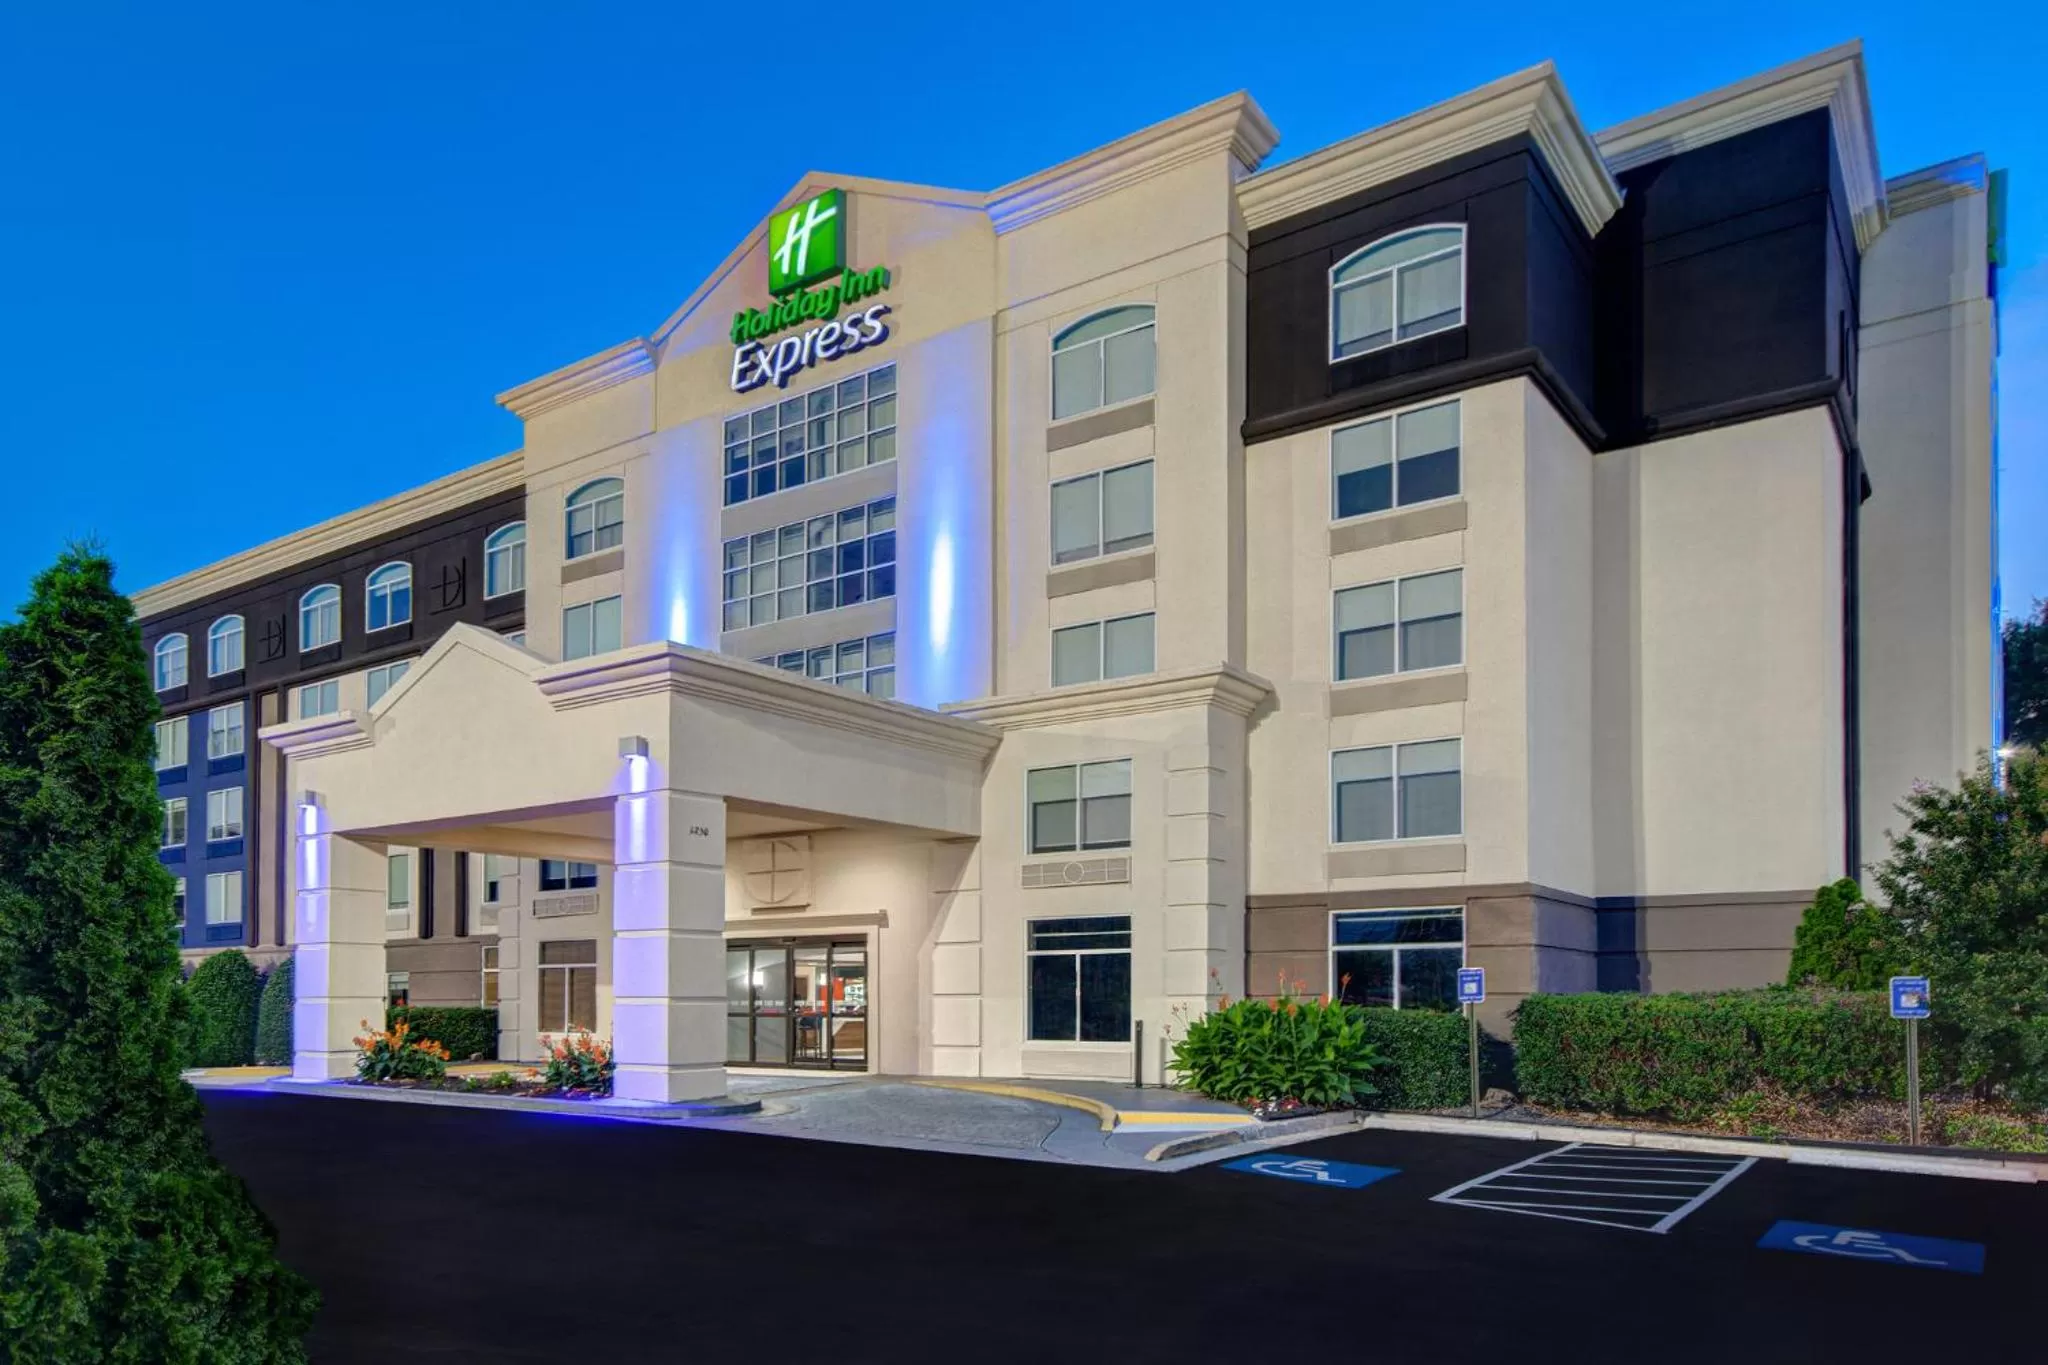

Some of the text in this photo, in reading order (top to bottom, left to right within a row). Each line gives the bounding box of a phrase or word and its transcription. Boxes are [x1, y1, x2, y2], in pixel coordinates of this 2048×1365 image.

[773, 199, 838, 276] H
[730, 264, 890, 345] Holiday Inn
[731, 304, 891, 393] Express
